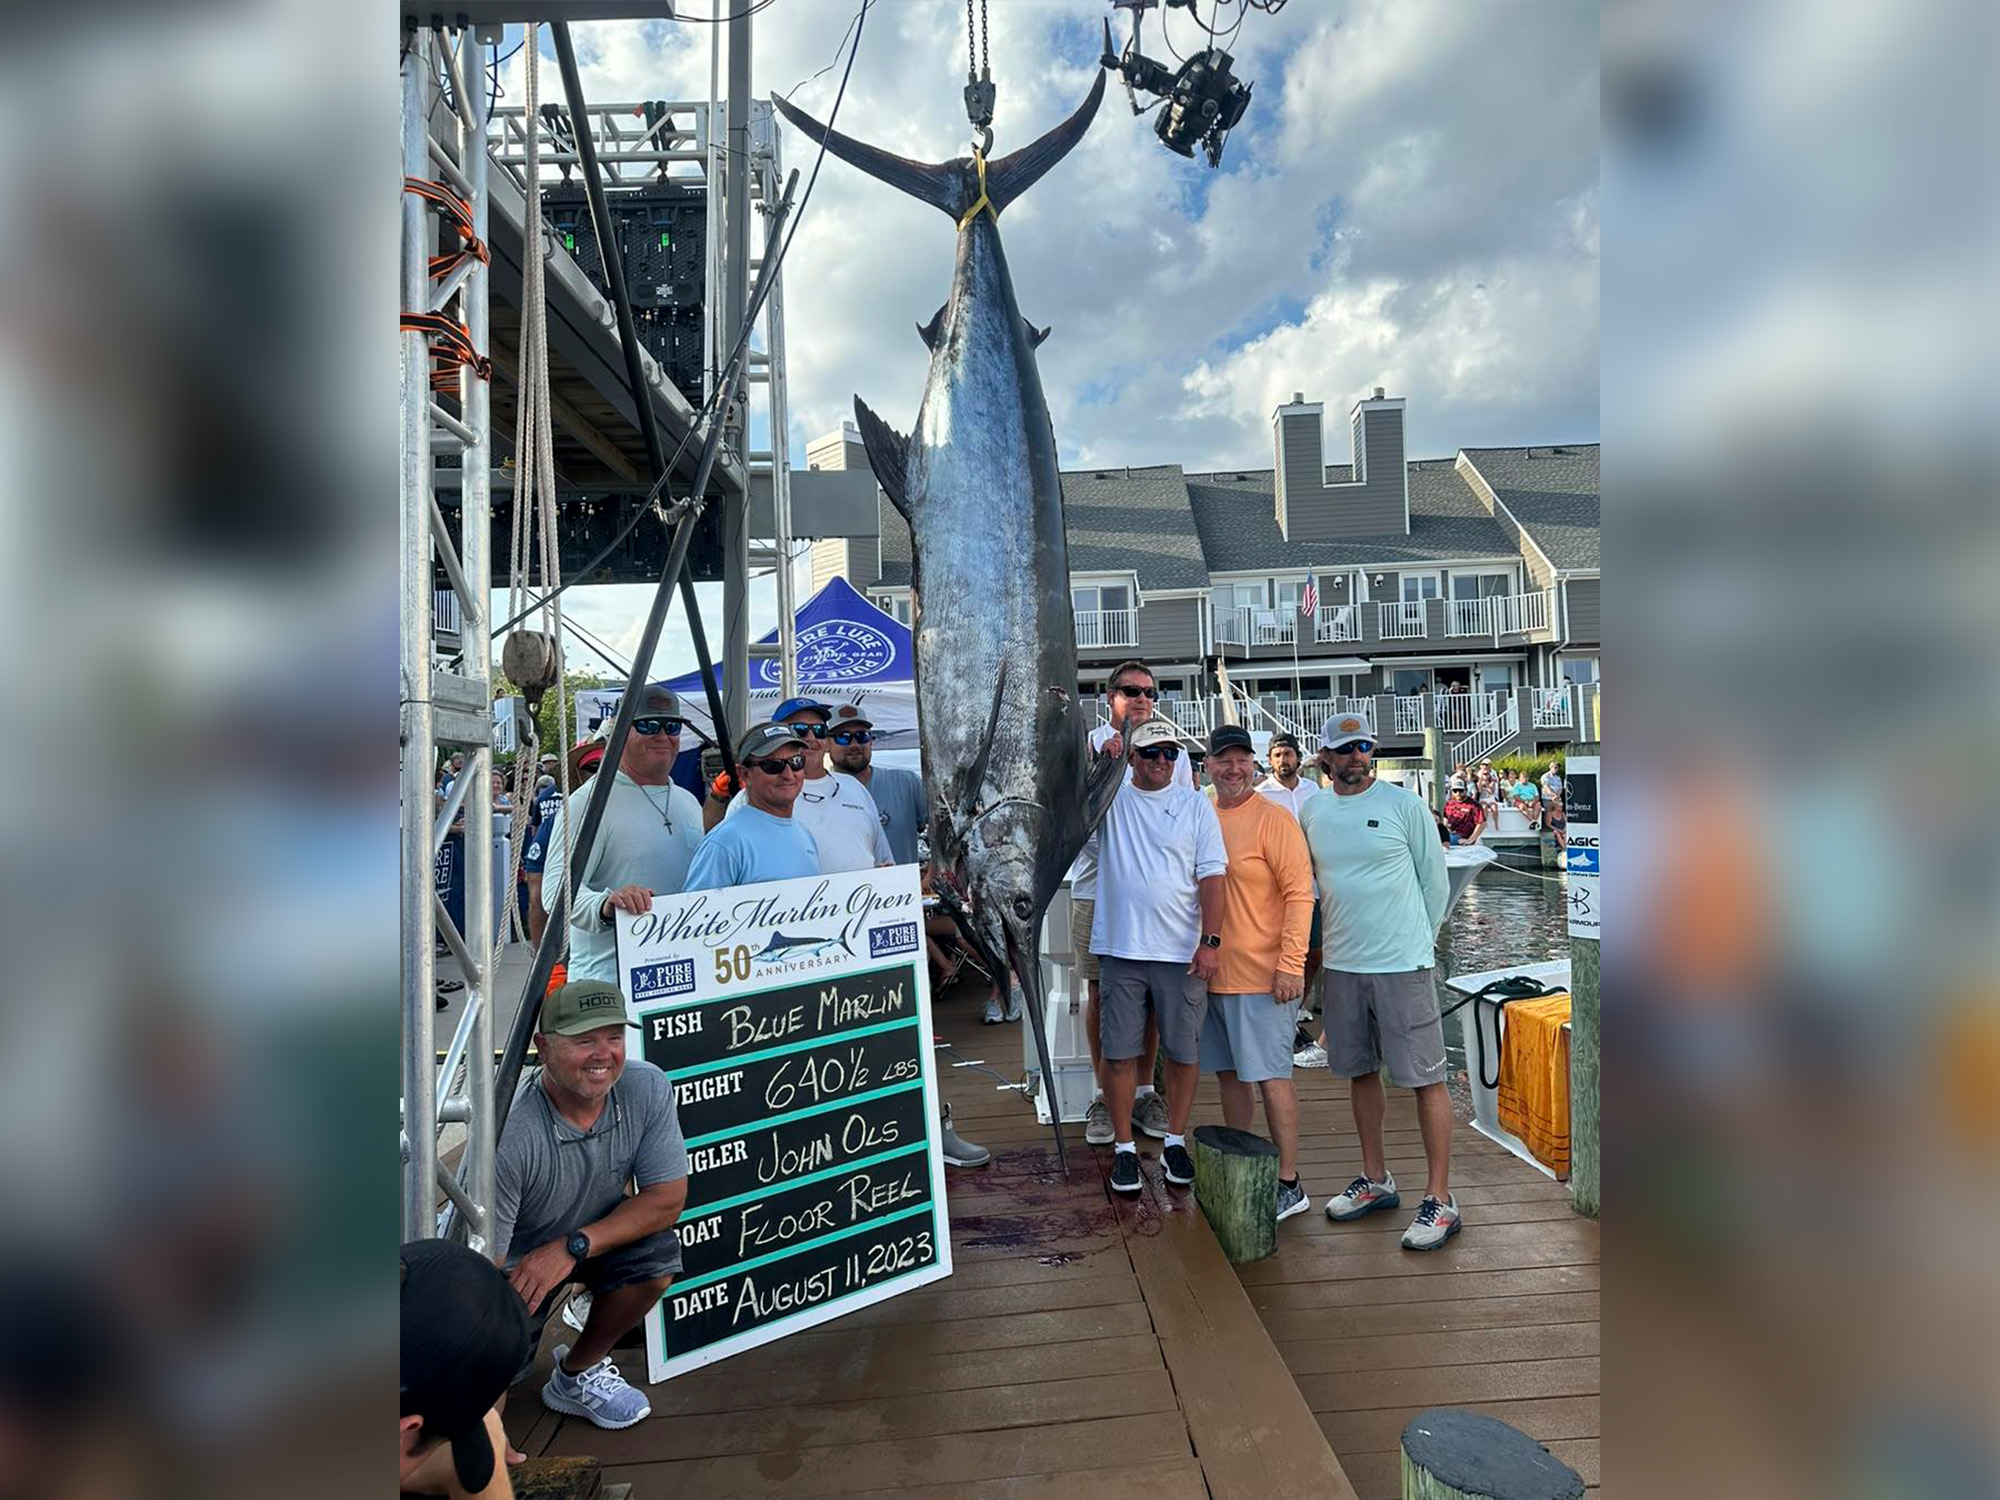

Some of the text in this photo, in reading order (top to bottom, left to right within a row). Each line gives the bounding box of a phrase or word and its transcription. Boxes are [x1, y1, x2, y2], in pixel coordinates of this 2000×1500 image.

[796, 625, 882, 650] URE LURE
[1567, 836, 1599, 847] AGIC
[631, 880, 914, 947] White Marlin Open
[888, 925, 916, 937] PURE
[889, 934, 917, 946] LURE
[656, 962, 692, 977] PURE
[756, 954, 849, 978] ANNIVERSARY
[657, 973, 693, 987] LURE
[653, 1011, 703, 1041] FISH
[720, 1004, 804, 1051] BLUE
[882, 1058, 919, 1082] LBS
[757, 1114, 899, 1183] JOHN OLS
[738, 1171, 922, 1258] FLOOR REEL
[673, 1282, 729, 1321] DATE
[732, 1265, 838, 1326] AUGUST
